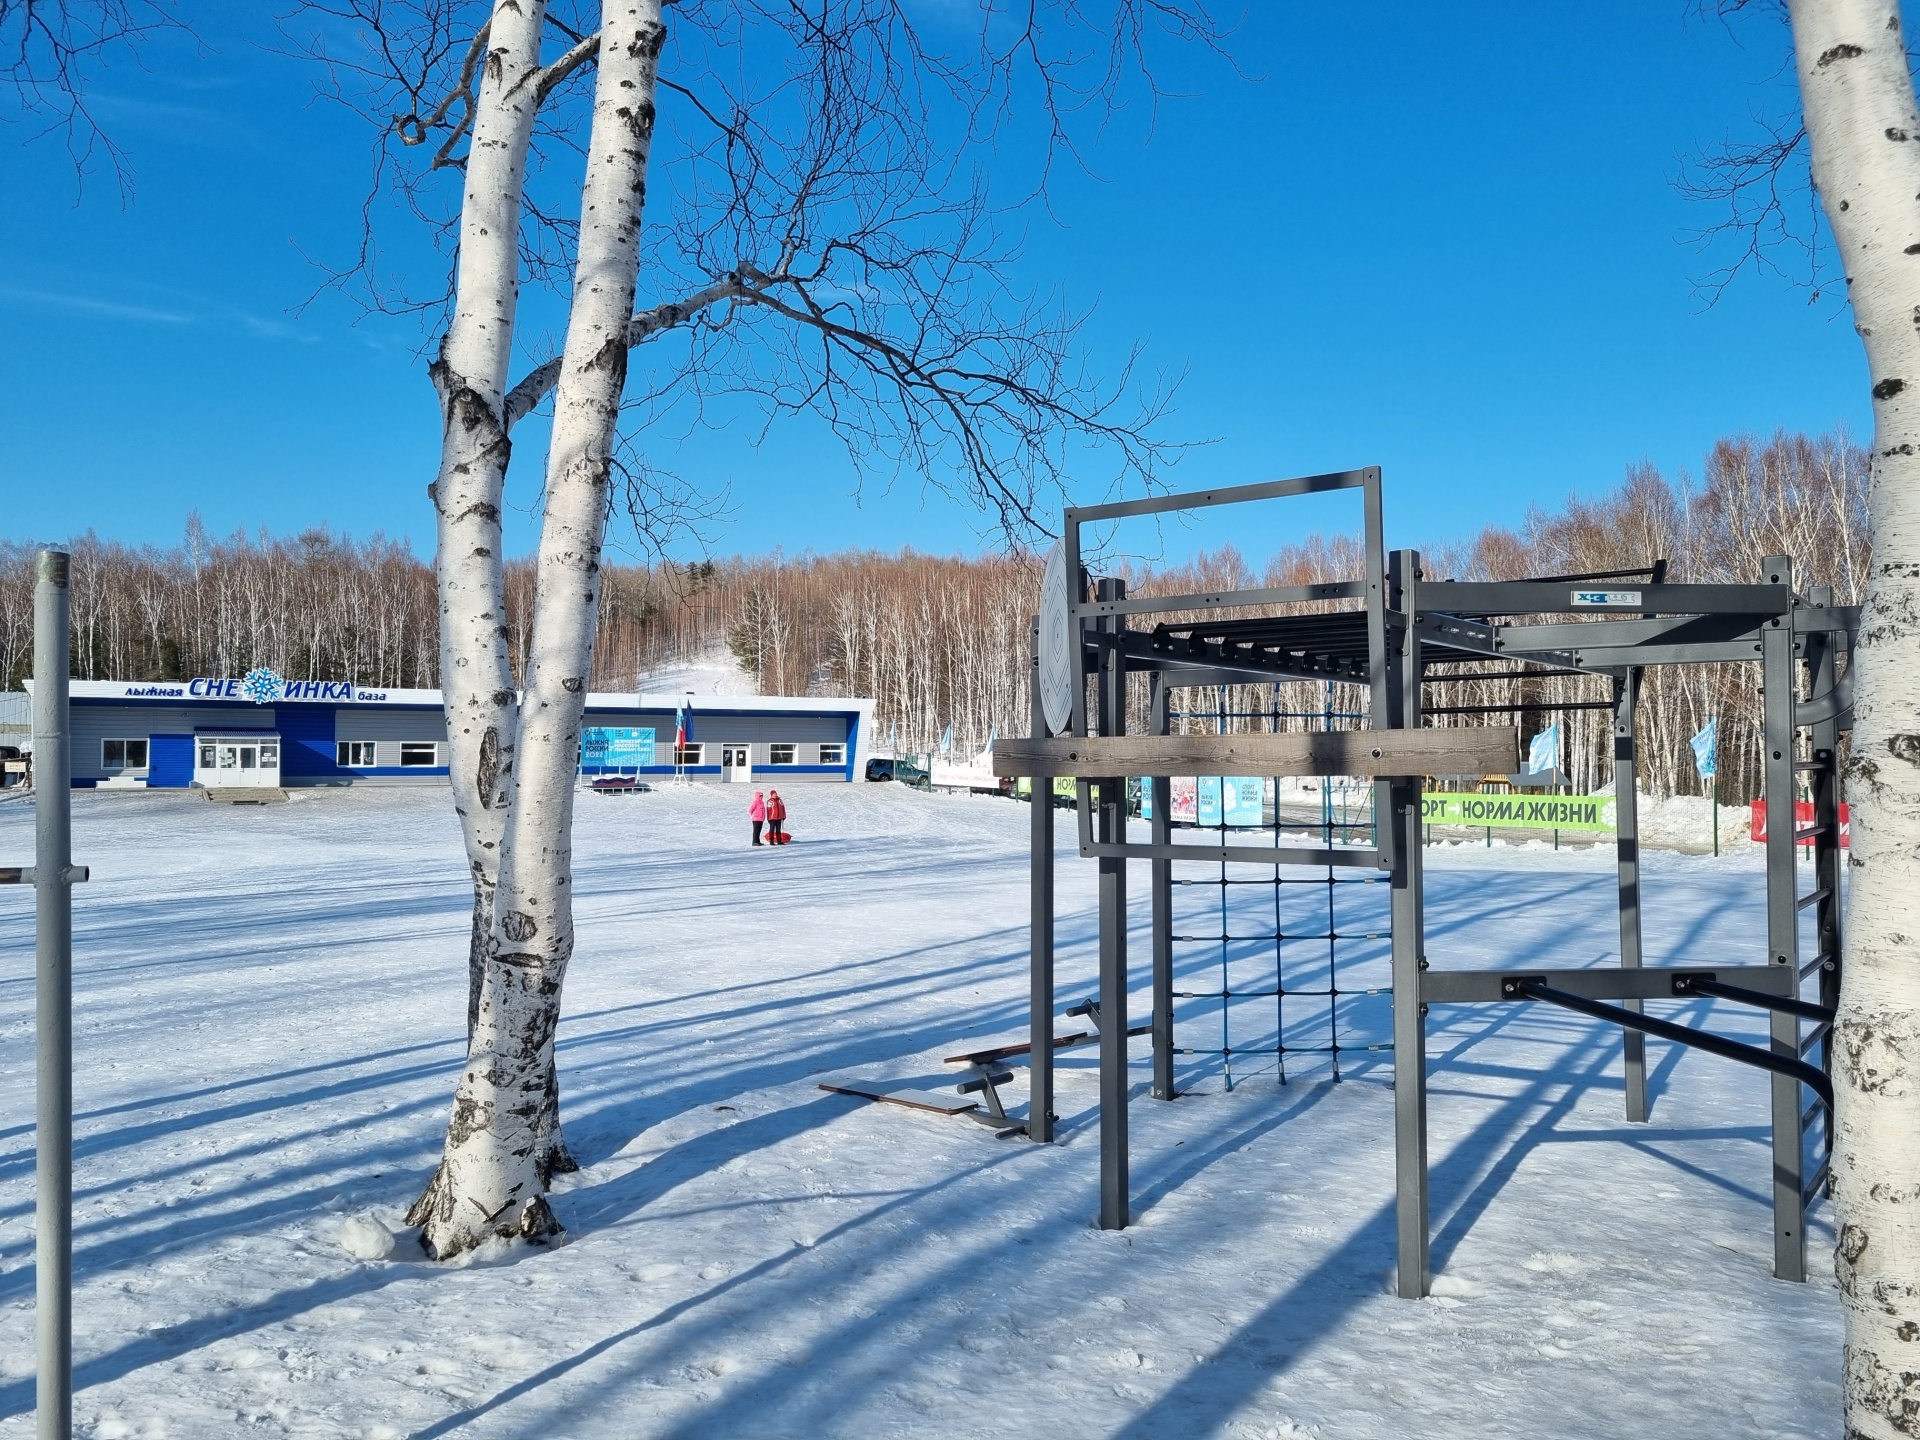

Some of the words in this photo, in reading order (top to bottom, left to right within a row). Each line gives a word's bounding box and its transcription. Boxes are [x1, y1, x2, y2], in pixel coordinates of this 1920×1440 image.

[125, 686, 183, 697] лыжная
[358, 691, 387, 701] база
[1421, 799, 1448, 817] ОРТ
[1462, 800, 1525, 821] НОРМА
[1526, 801, 1597, 823] ЖИЗНИ
